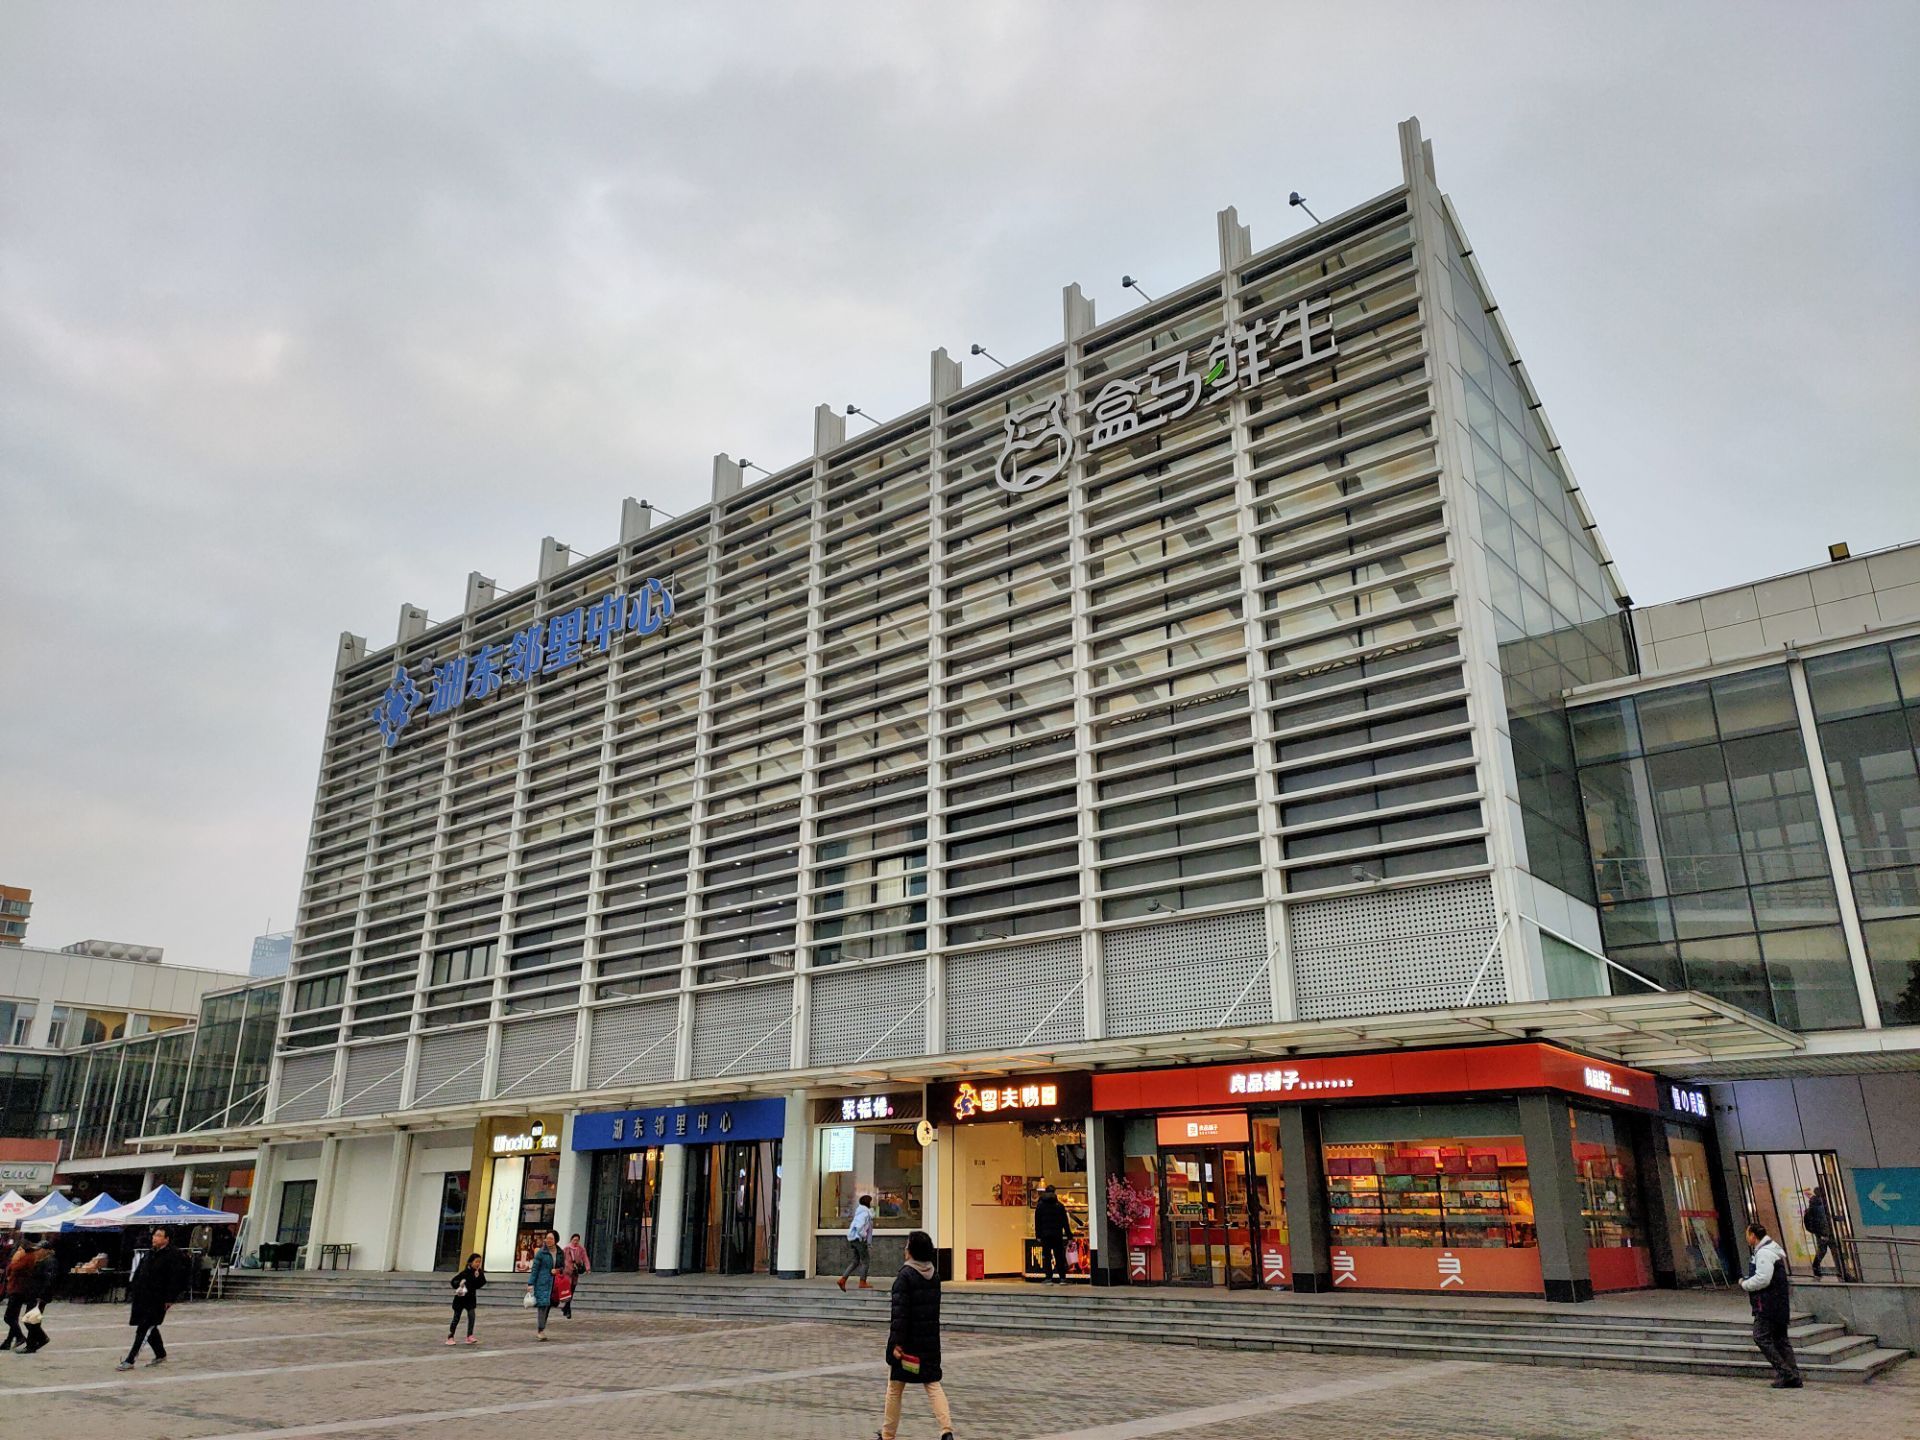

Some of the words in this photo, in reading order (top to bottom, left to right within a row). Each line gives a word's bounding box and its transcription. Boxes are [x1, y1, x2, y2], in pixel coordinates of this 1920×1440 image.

[1087, 299, 1339, 451] 盒马鲜生
[428, 577, 676, 716] 湖东邻里中心
[1230, 1071, 1299, 1093] 良品铺子
[612, 1111, 731, 1141] 湖东邻里中心
[0, 1167, 39, 1180] and
